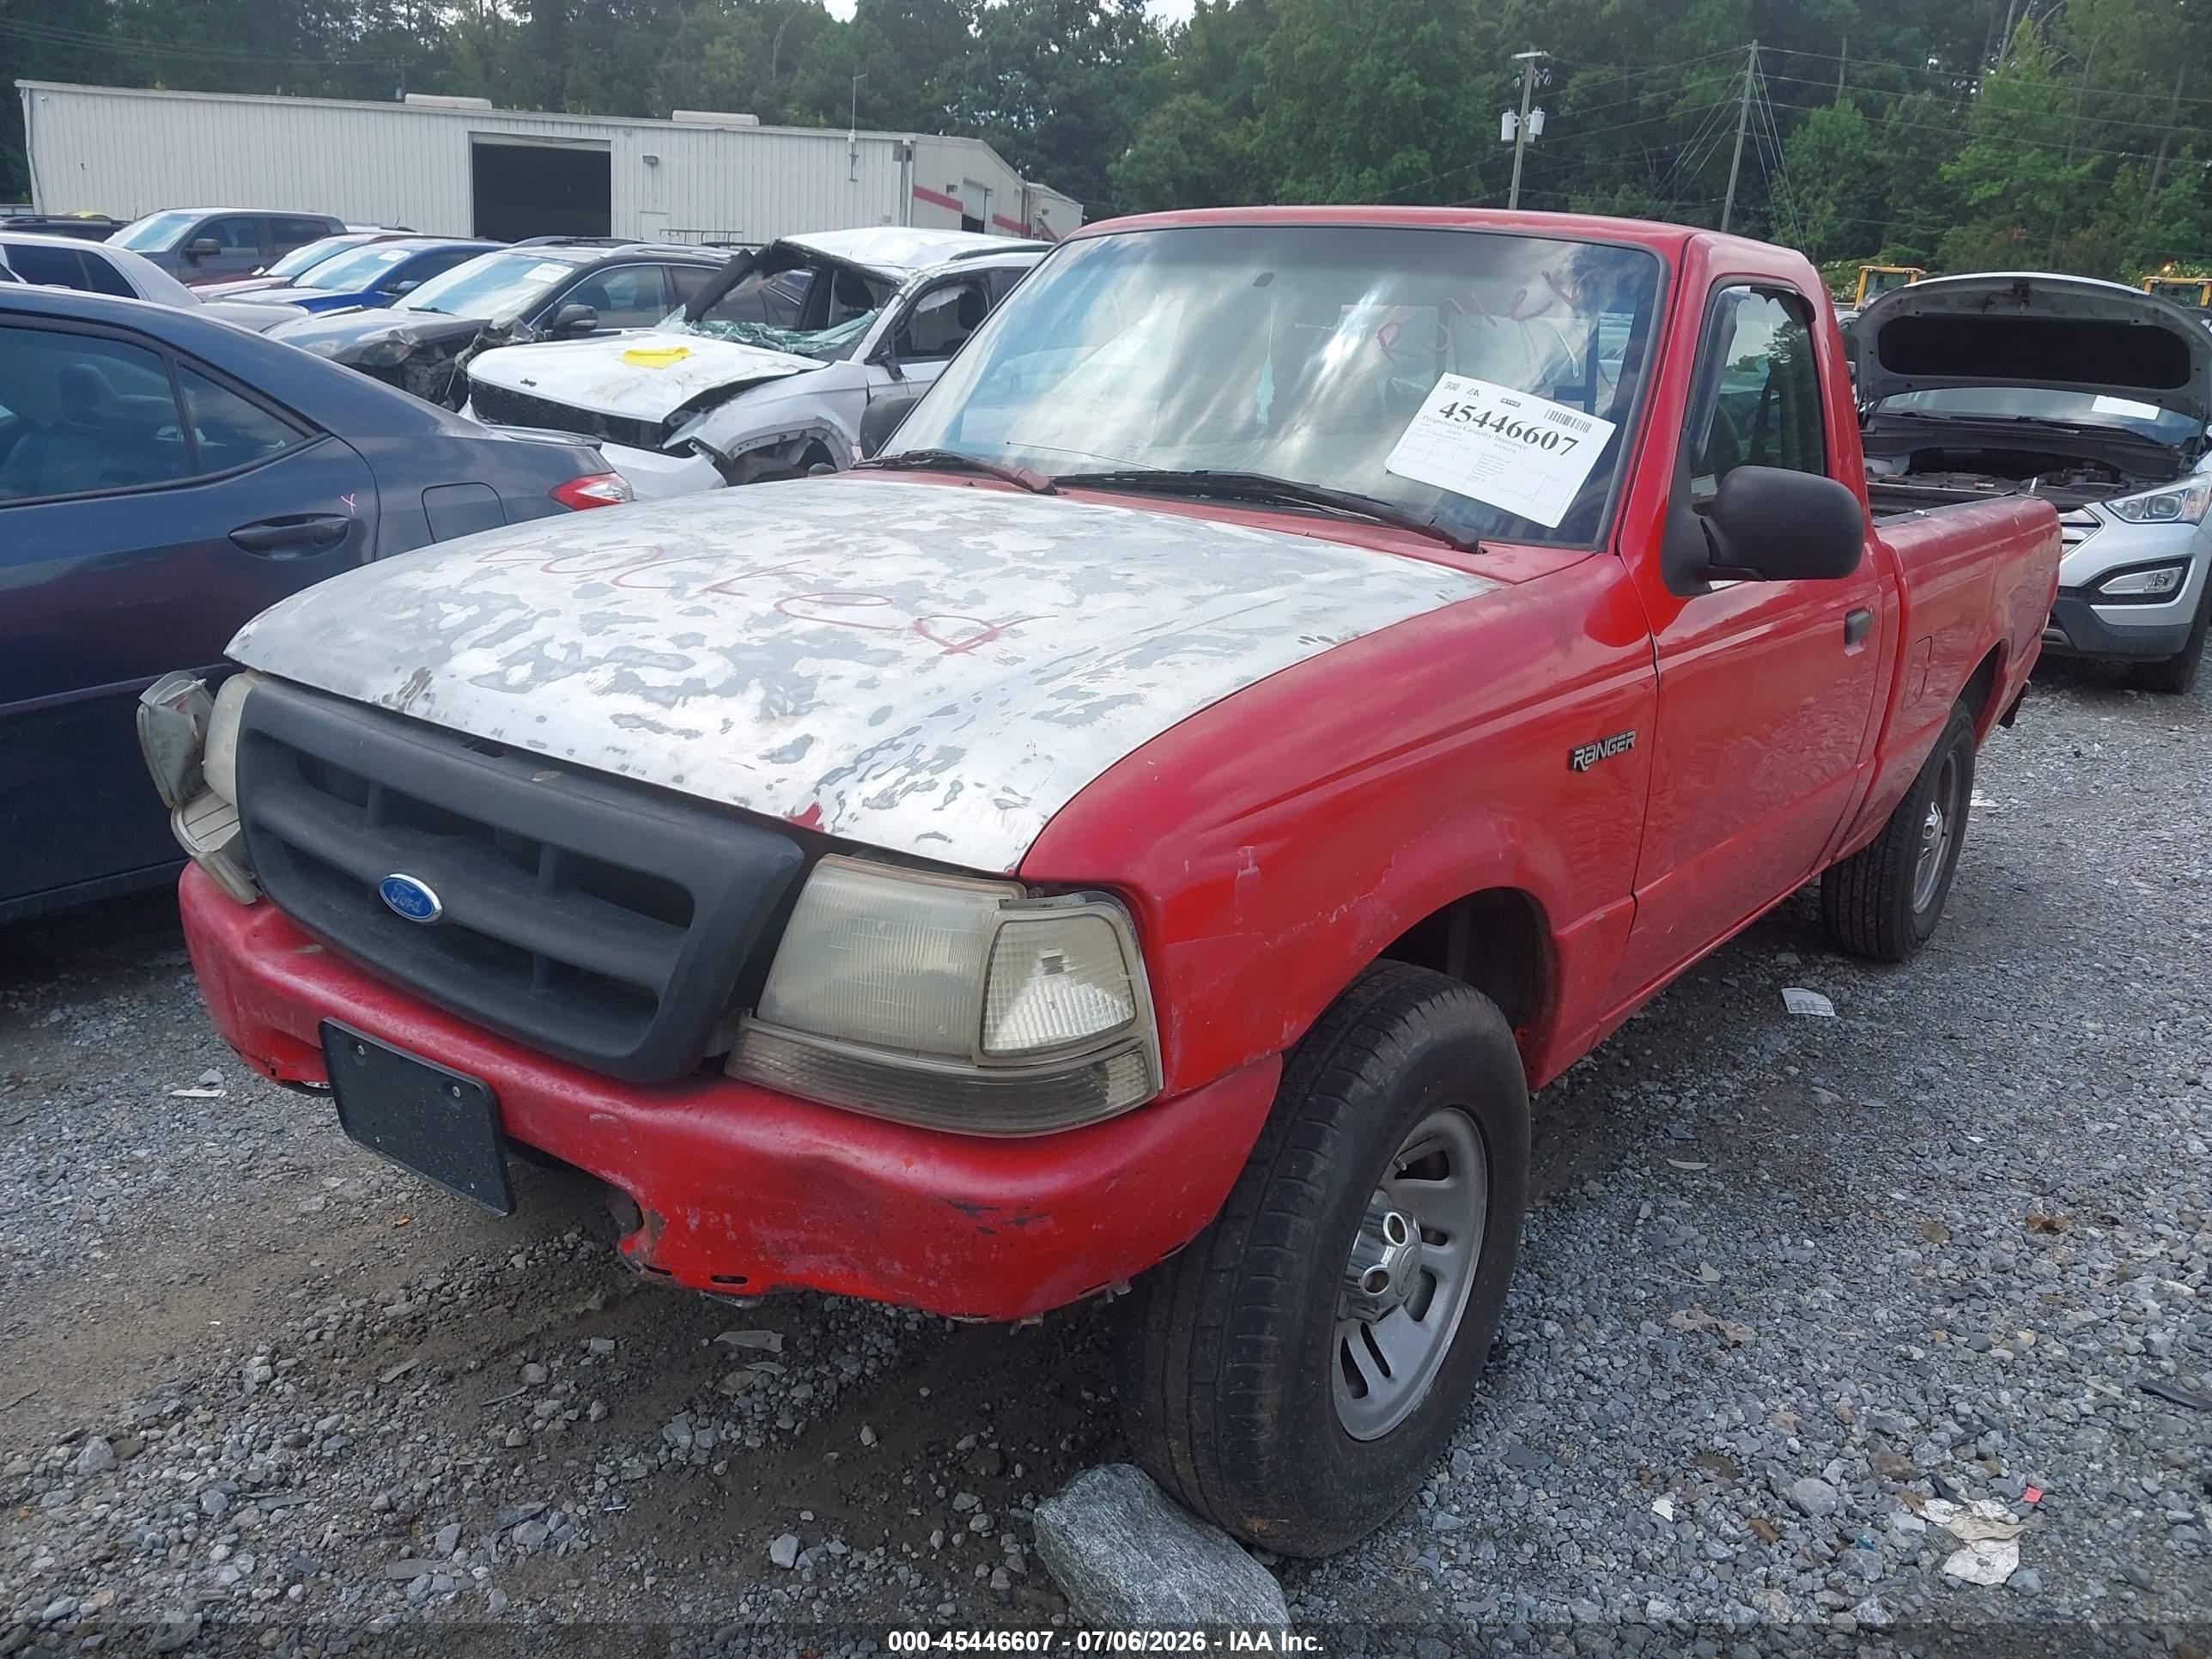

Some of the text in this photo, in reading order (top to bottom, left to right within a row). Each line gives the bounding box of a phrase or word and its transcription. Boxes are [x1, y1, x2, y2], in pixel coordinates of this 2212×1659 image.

[1422, 415, 1462, 430] Progressive
[1463, 425, 1492, 441] Casualty
[1494, 434, 1528, 450] Insurance
[1438, 401, 1580, 456] 45446607
[391, 882, 424, 913] Ford
